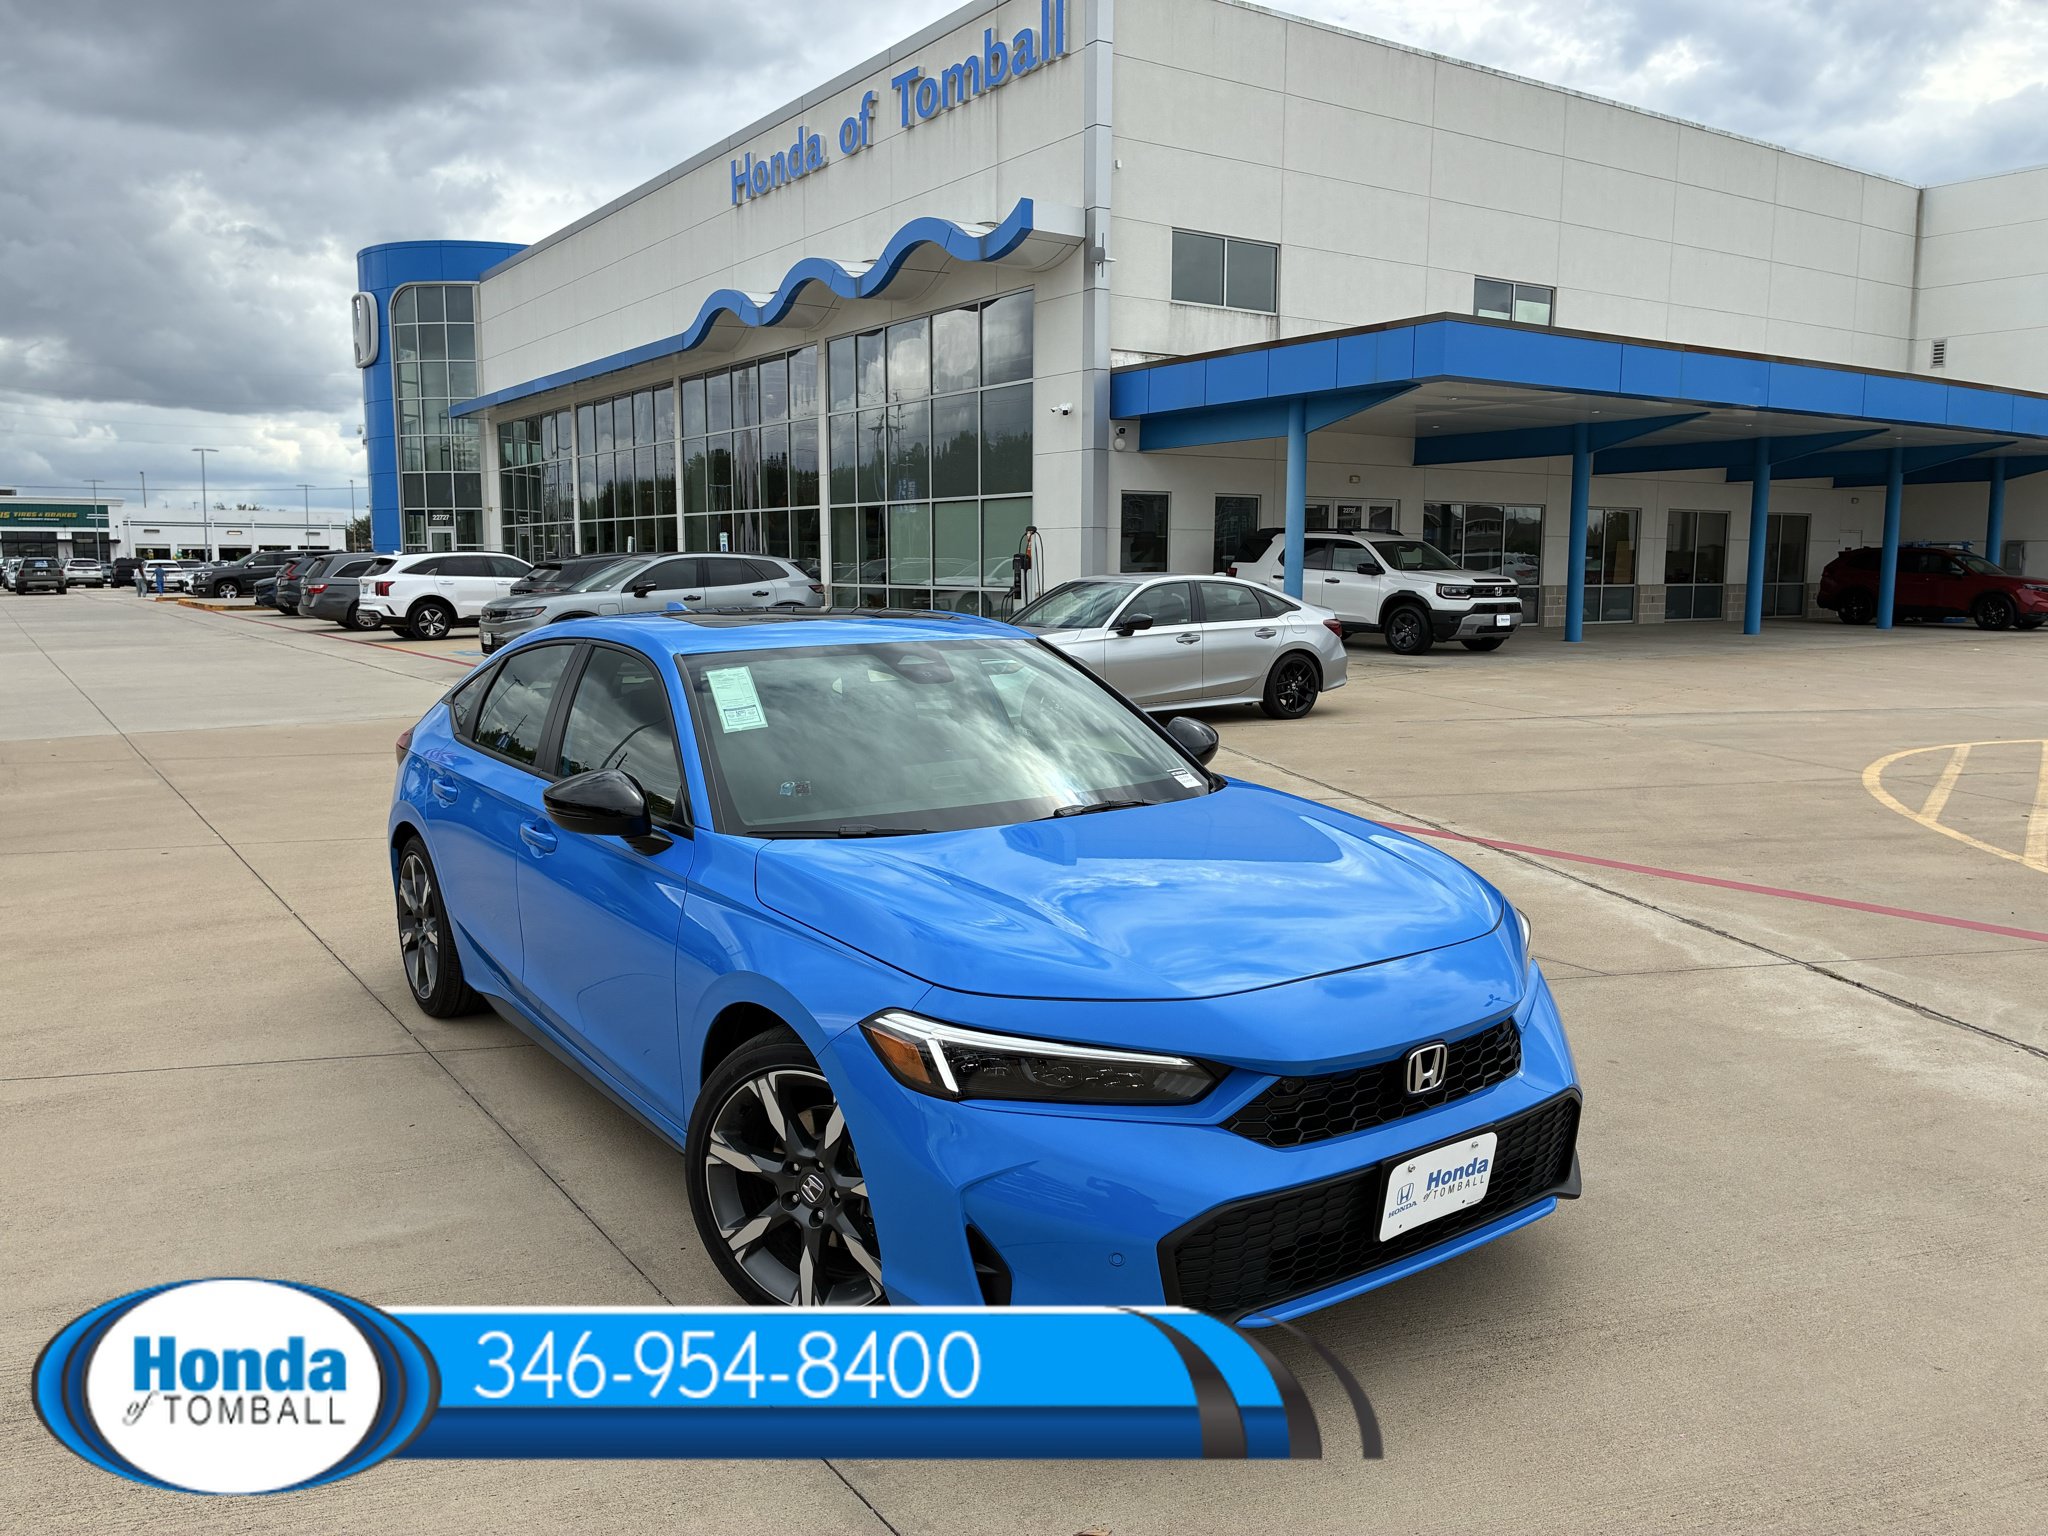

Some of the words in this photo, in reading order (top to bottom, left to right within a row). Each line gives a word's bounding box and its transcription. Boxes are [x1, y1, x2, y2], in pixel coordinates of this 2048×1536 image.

[731, 126, 826, 205] Honda
[839, 91, 876, 154] of
[892, 0, 1068, 128] Tomball
[1426, 1157, 1489, 1191] Honda
[1433, 1175, 1485, 1200] TOMBALL
[1388, 1200, 1418, 1218] HONDA
